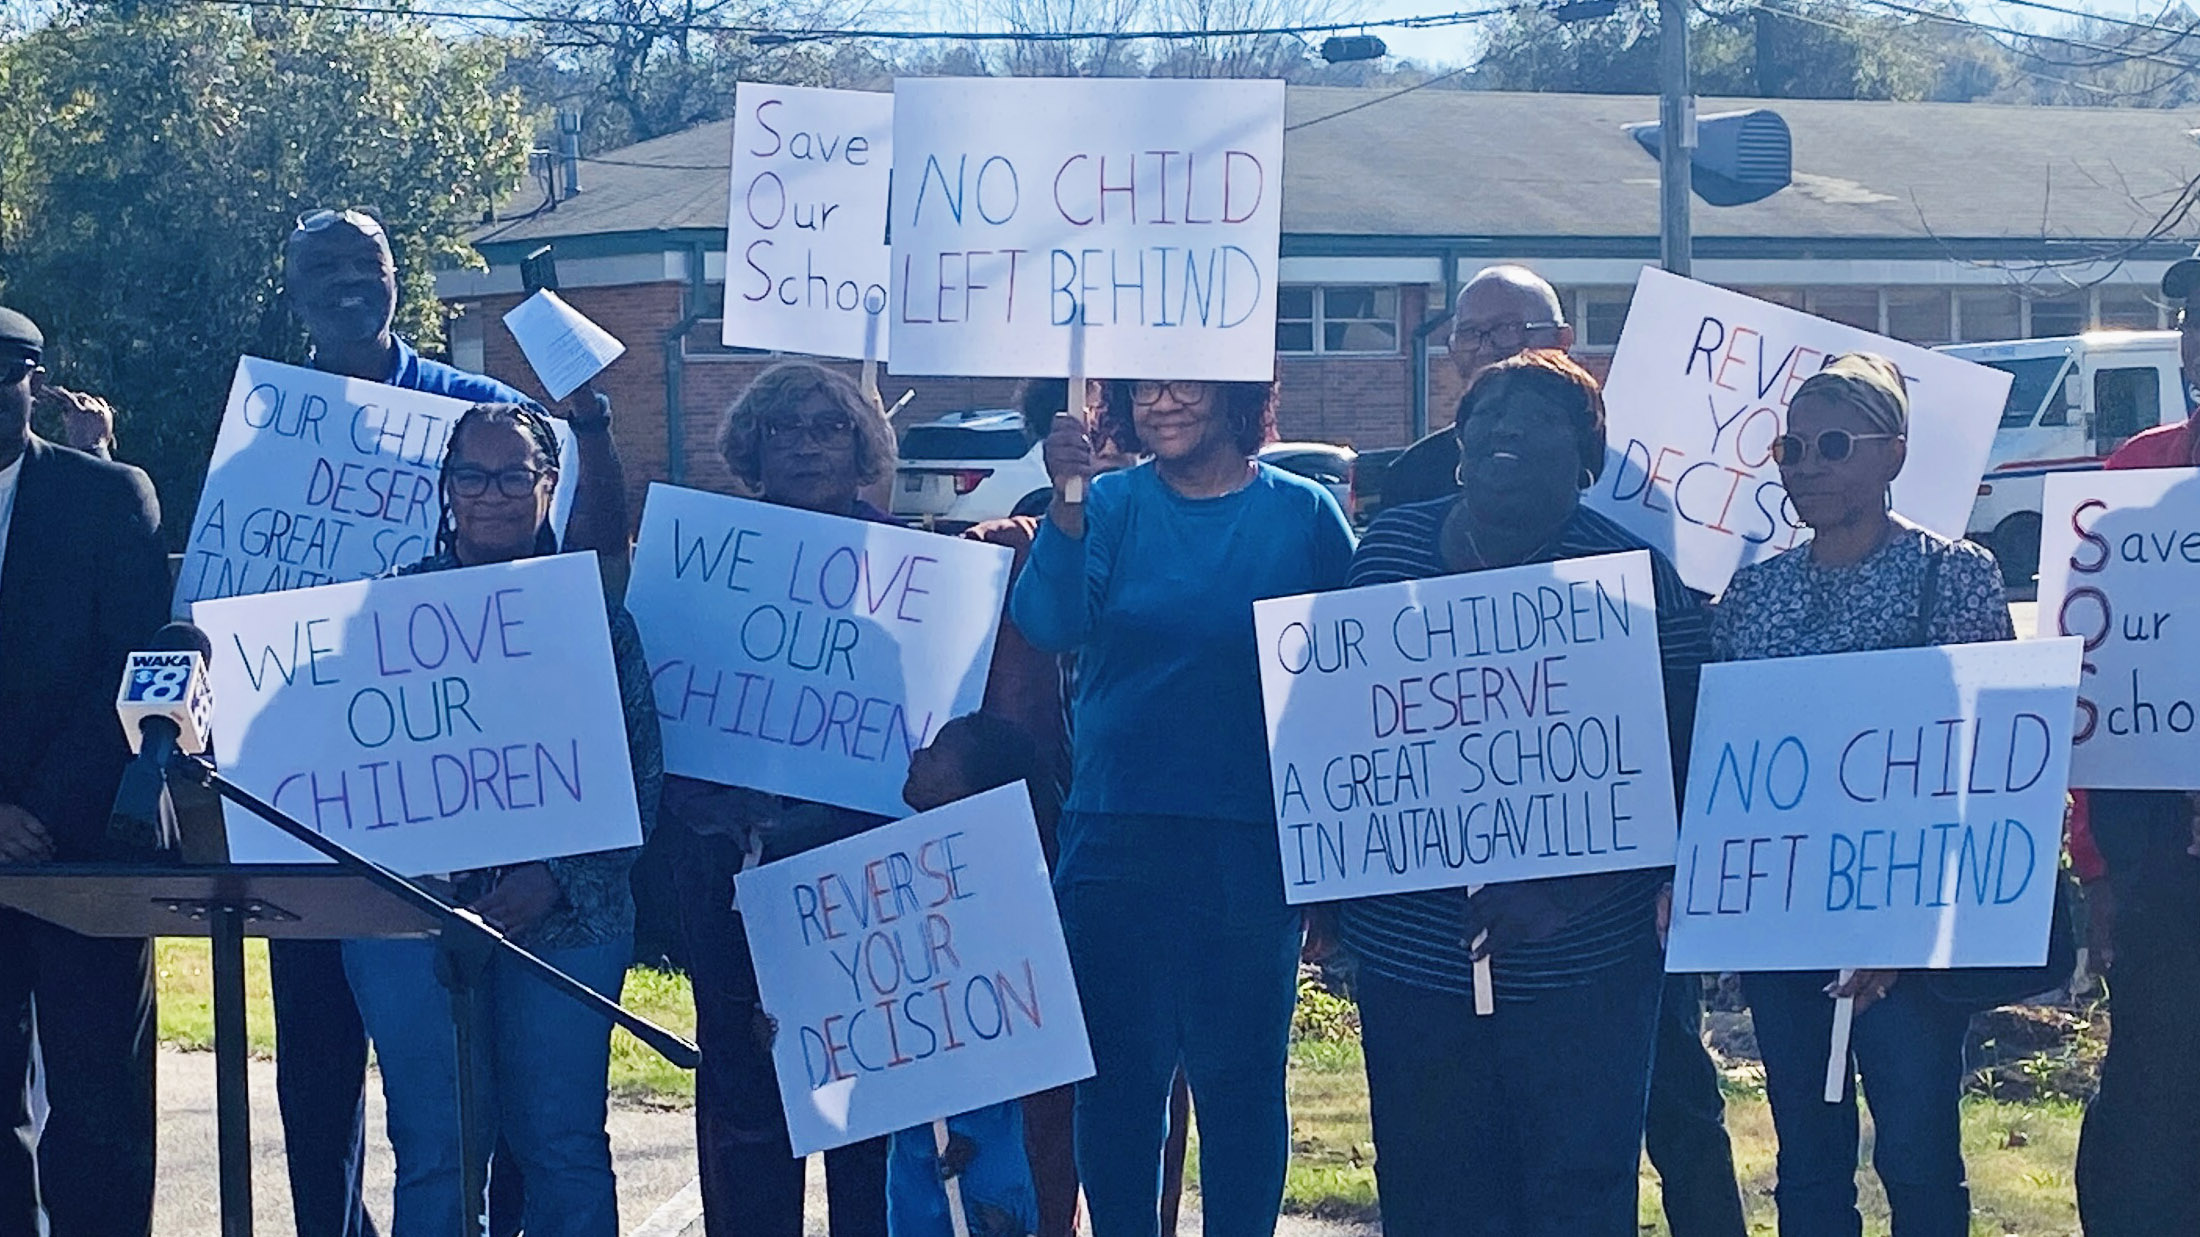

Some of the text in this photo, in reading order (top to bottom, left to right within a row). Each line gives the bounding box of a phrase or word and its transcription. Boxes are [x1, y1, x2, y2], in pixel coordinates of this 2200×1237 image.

[750, 100, 869, 165] Save
[747, 171, 841, 231] Our
[913, 150, 1263, 227] NO CHILD
[743, 239, 887, 316] Schoo
[902, 245, 1261, 328] LEFT BEHIND
[1685, 316, 1920, 406] REVE
[243, 383, 451, 469] OUR CHIL
[1708, 393, 1782, 468] YO
[196, 498, 225, 547] A
[240, 507, 354, 570] GREAT
[307, 457, 433, 528] DESER
[1612, 438, 1802, 551] DECIS
[674, 518, 938, 623] WE LOVE
[2069, 498, 2200, 574] Save
[234, 618, 339, 692] WE
[374, 588, 531, 676] LOVE
[741, 604, 859, 681] OUR
[1278, 573, 1630, 674] OUR CHILDREN
[2058, 585, 2171, 652] Our
[132, 655, 191, 667] WAKA
[142, 666, 188, 702] 8
[1372, 655, 1571, 739] DESERVE
[347, 677, 483, 748] OUR
[649, 659, 932, 763] CHILDREN
[1280, 715, 1642, 818] A GREAT SCHOOL
[1706, 713, 2050, 815] NO CHILD
[1287, 781, 1638, 886] IN AUTAUGAVILLE
[1686, 819, 2036, 915] LEFT BEHIND
[792, 831, 978, 946] REVERSE
[829, 913, 961, 1003] YOUR
[799, 957, 1043, 1091] DECISION
